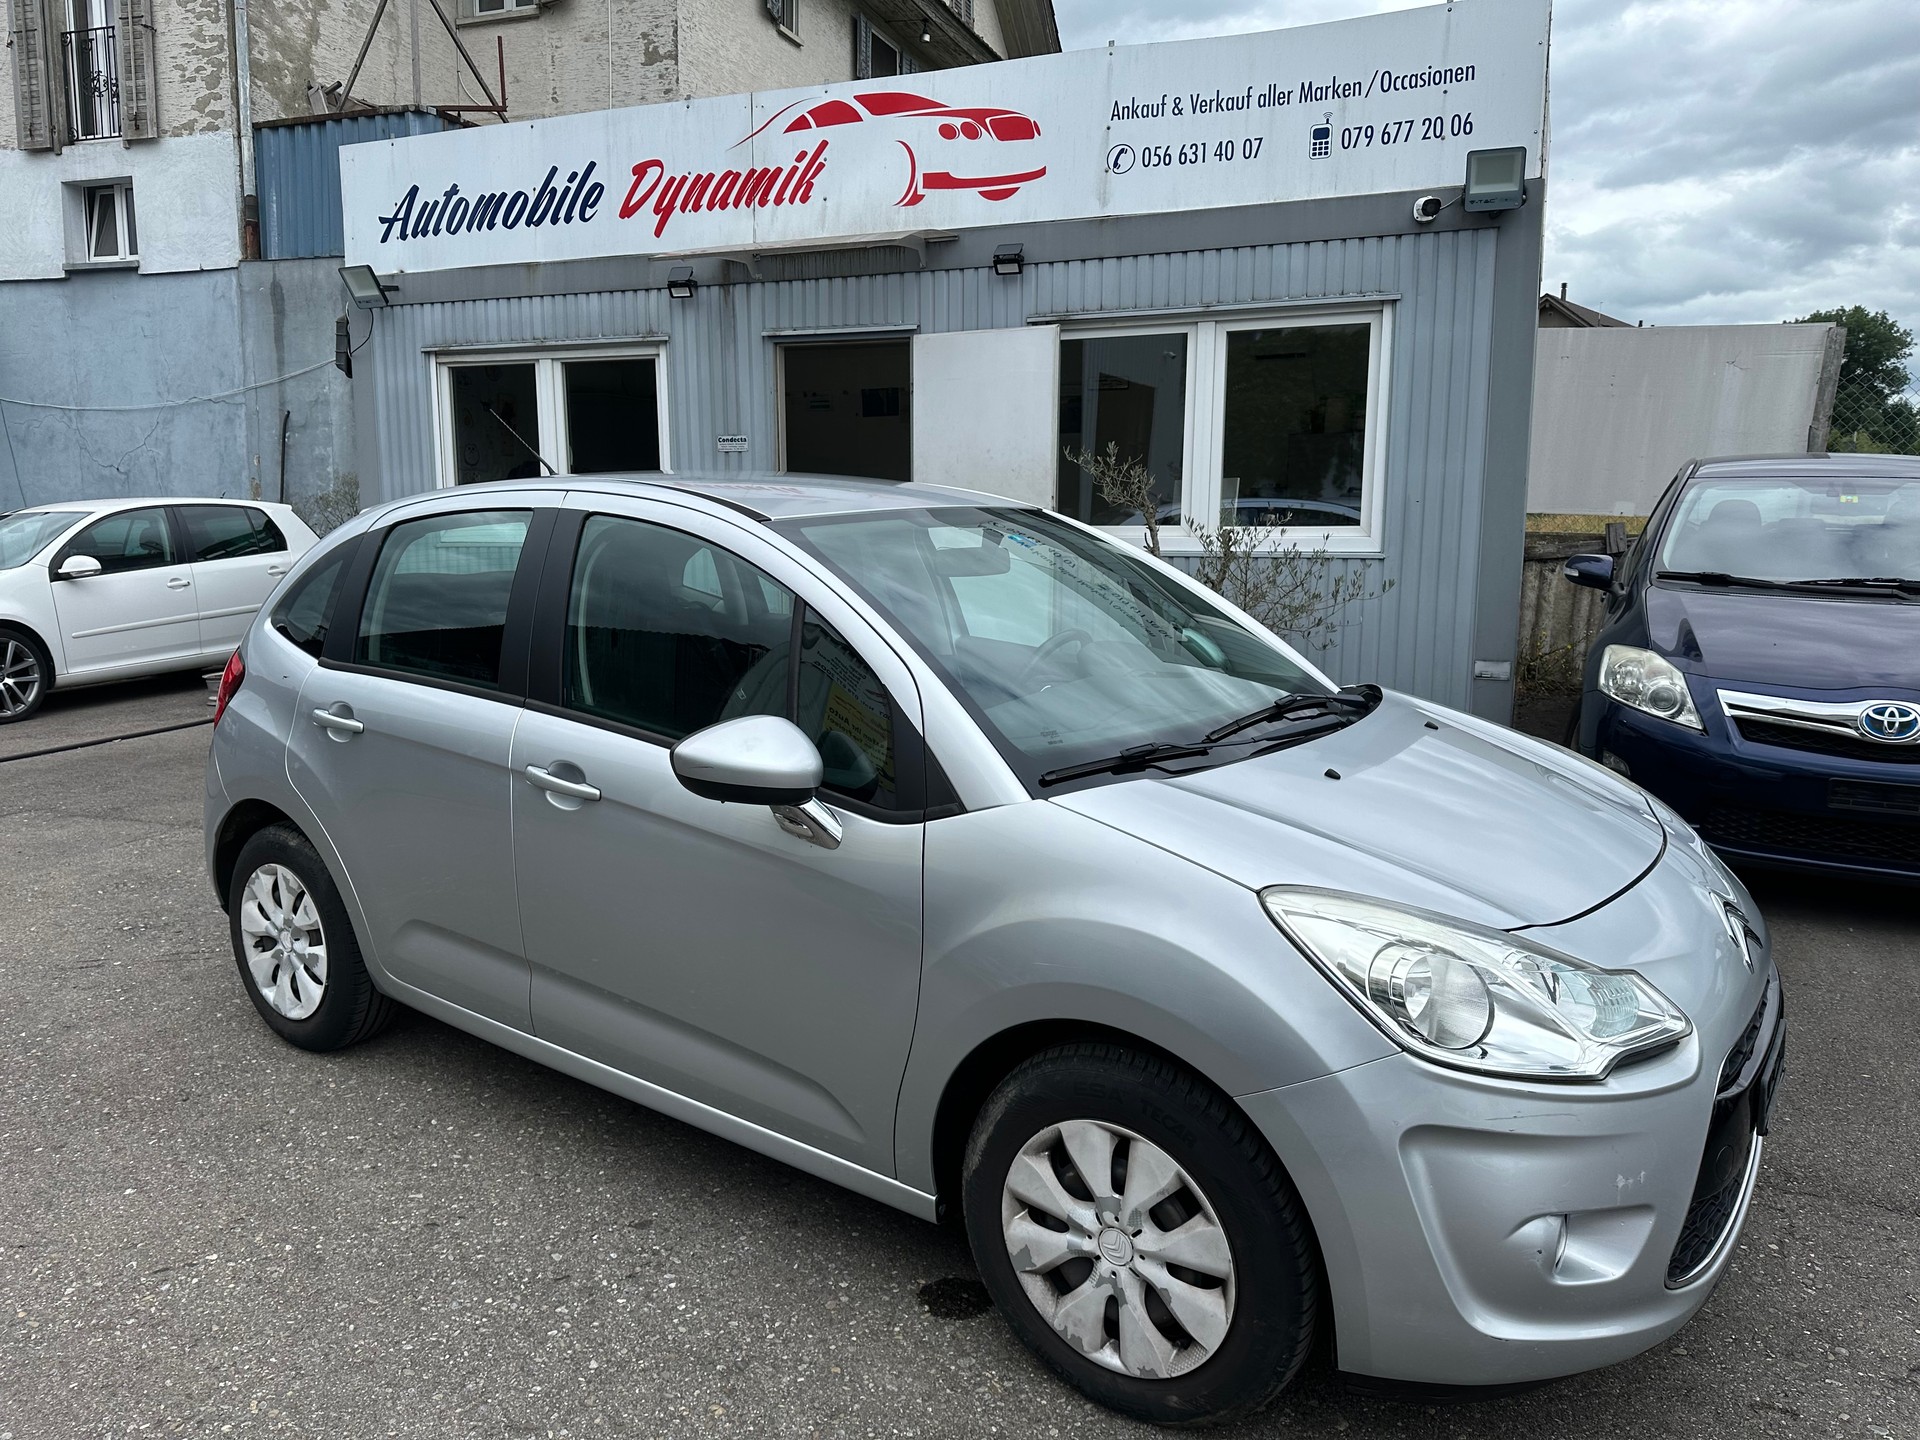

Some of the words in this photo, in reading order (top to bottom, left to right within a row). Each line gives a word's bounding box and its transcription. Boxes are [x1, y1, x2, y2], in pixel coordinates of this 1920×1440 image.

[1111, 94, 1167, 121] Ankauf
[1171, 97, 1184, 117] &
[1190, 86, 1253, 115] Verkauf
[1257, 84, 1294, 109] aller
[1298, 76, 1362, 104] Marken
[1341, 125, 1375, 150] 079
[1380, 120, 1415, 146] 677
[1421, 116, 1444, 141] 20
[1450, 112, 1474, 137] 06
[1141, 145, 1172, 168] 056
[1178, 142, 1207, 165] 631
[1213, 140, 1235, 162] 40
[1242, 137, 1264, 160] 07
[378, 160, 605, 244] Automobile
[618, 139, 829, 239] Dynamik
